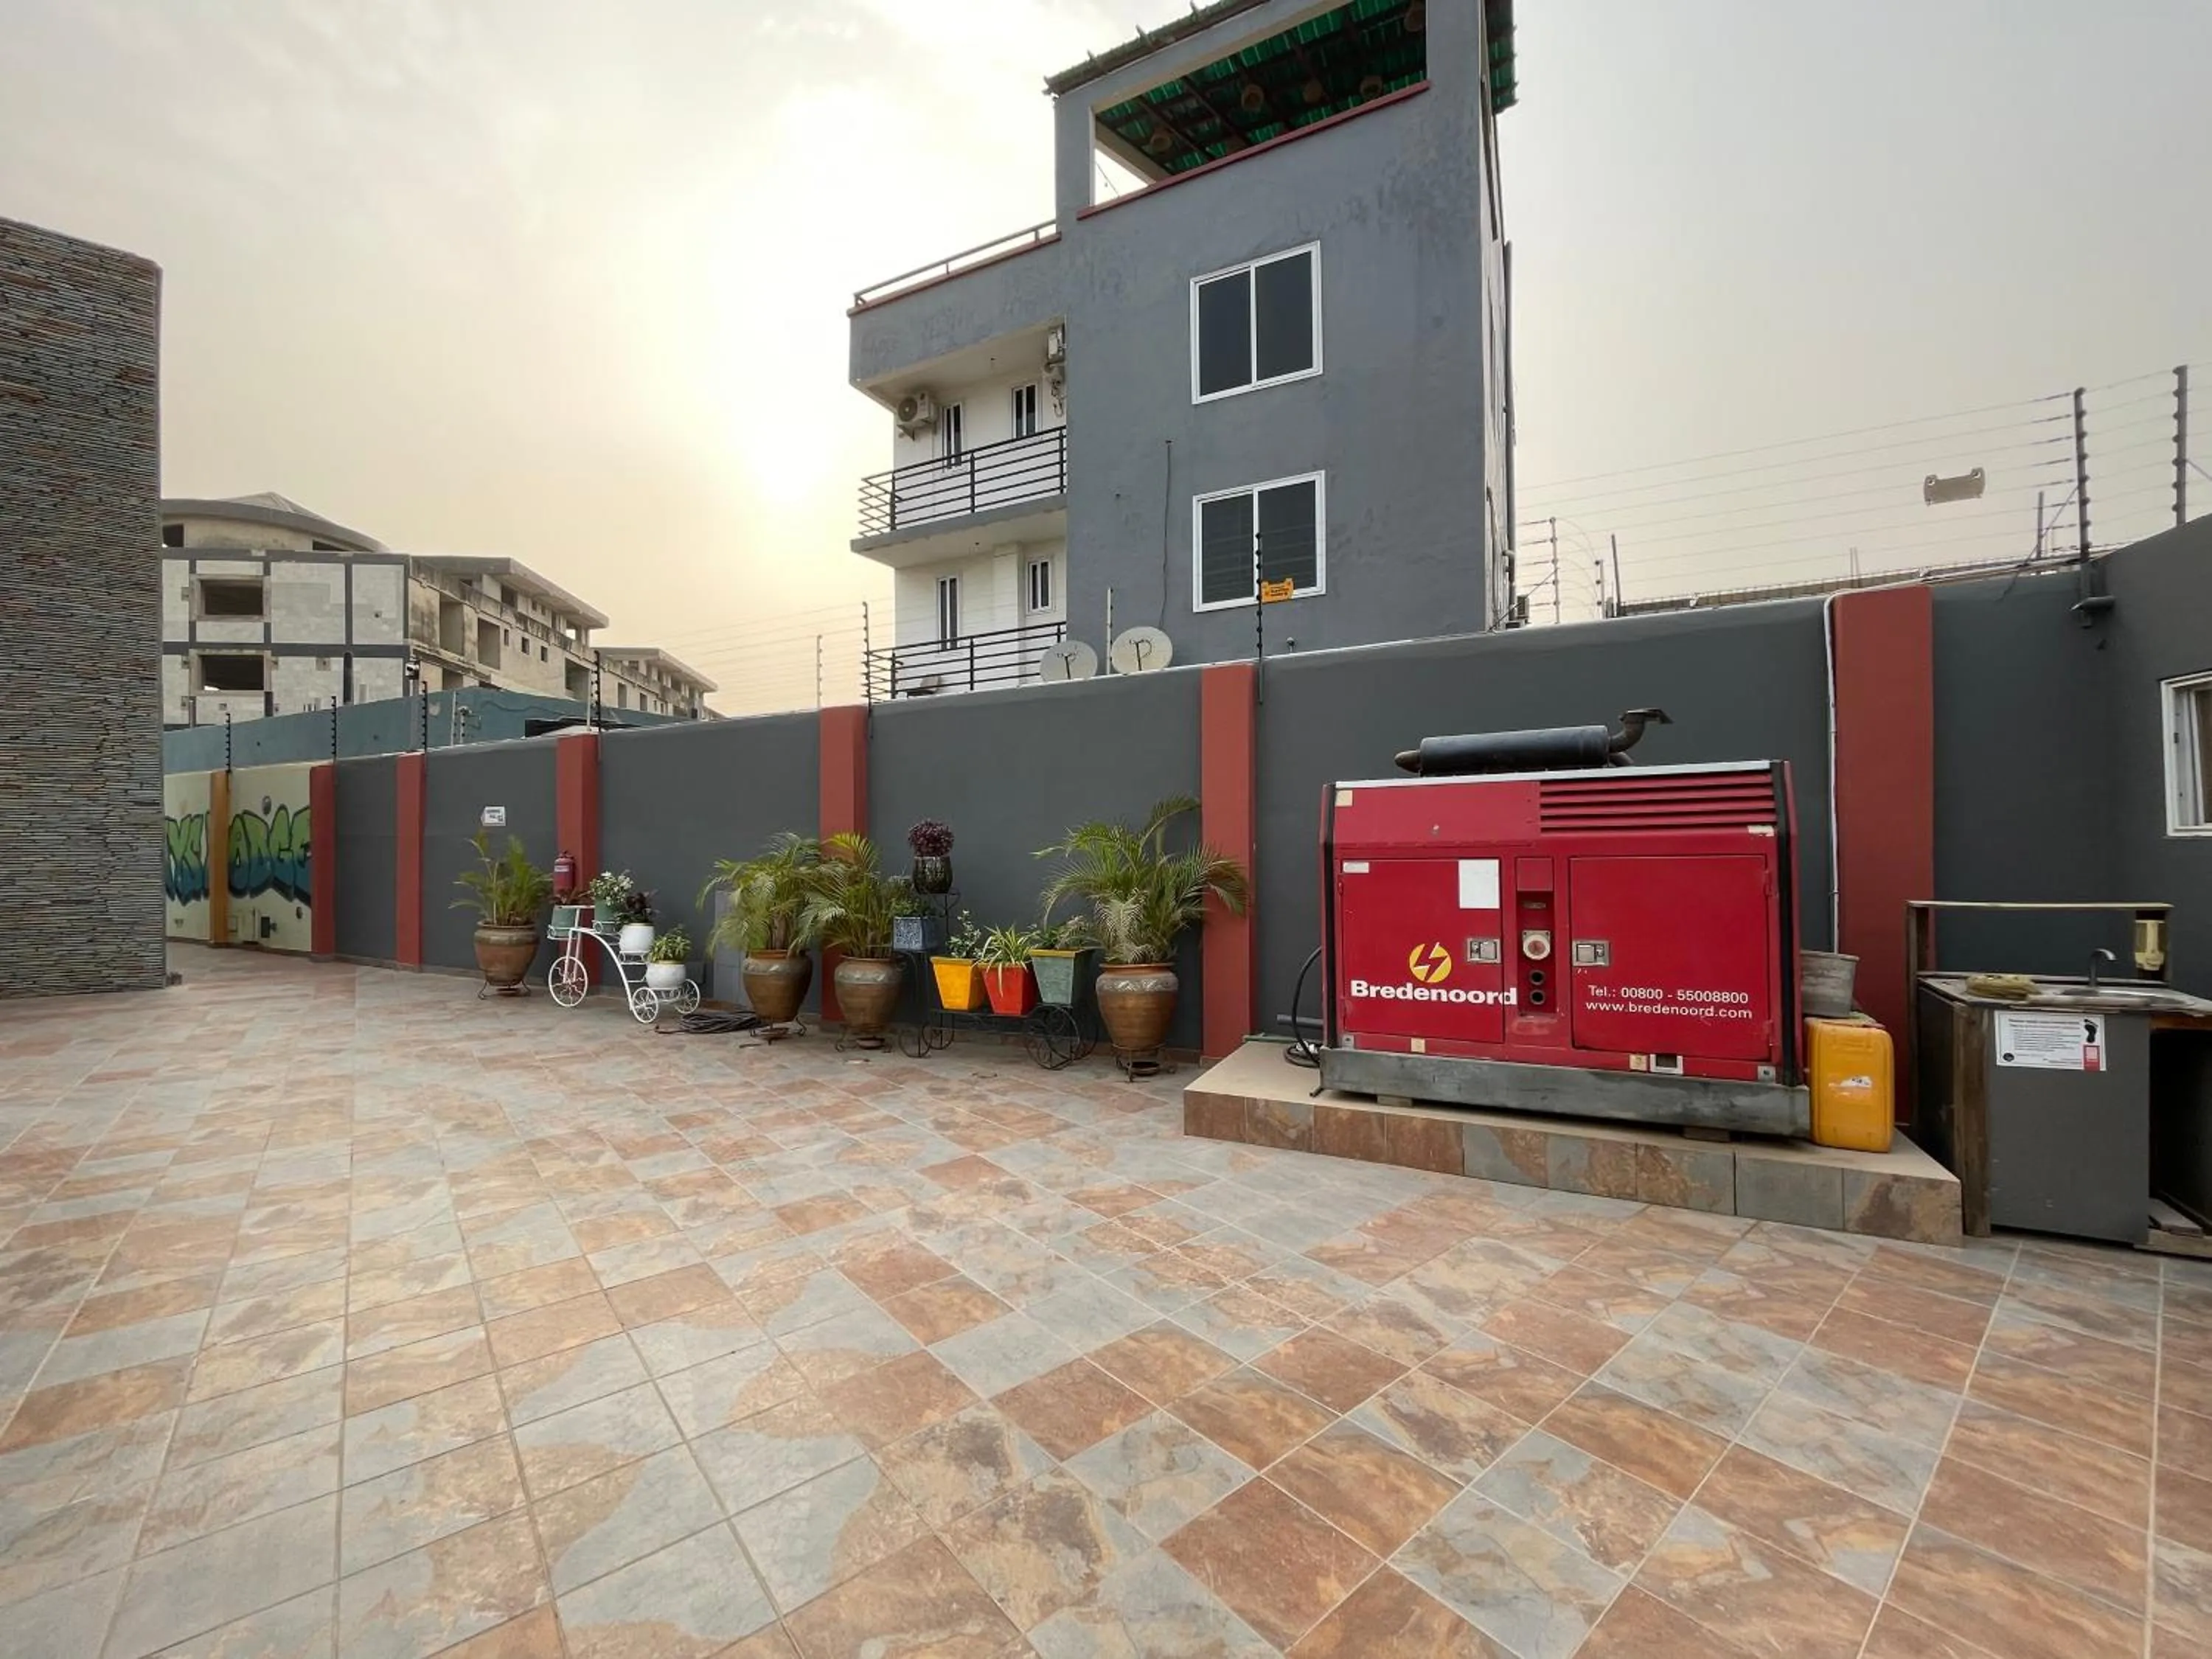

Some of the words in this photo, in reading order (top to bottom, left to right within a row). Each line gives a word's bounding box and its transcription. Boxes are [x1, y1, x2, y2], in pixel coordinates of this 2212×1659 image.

[1349, 978, 1518, 1006] Bredenoord
[1587, 984, 1617, 998] Tel.:
[1621, 987, 1664, 1001] 00800
[1677, 989, 1750, 1004] 55008800
[1585, 1001, 1753, 1020] www.bredenoord.com
